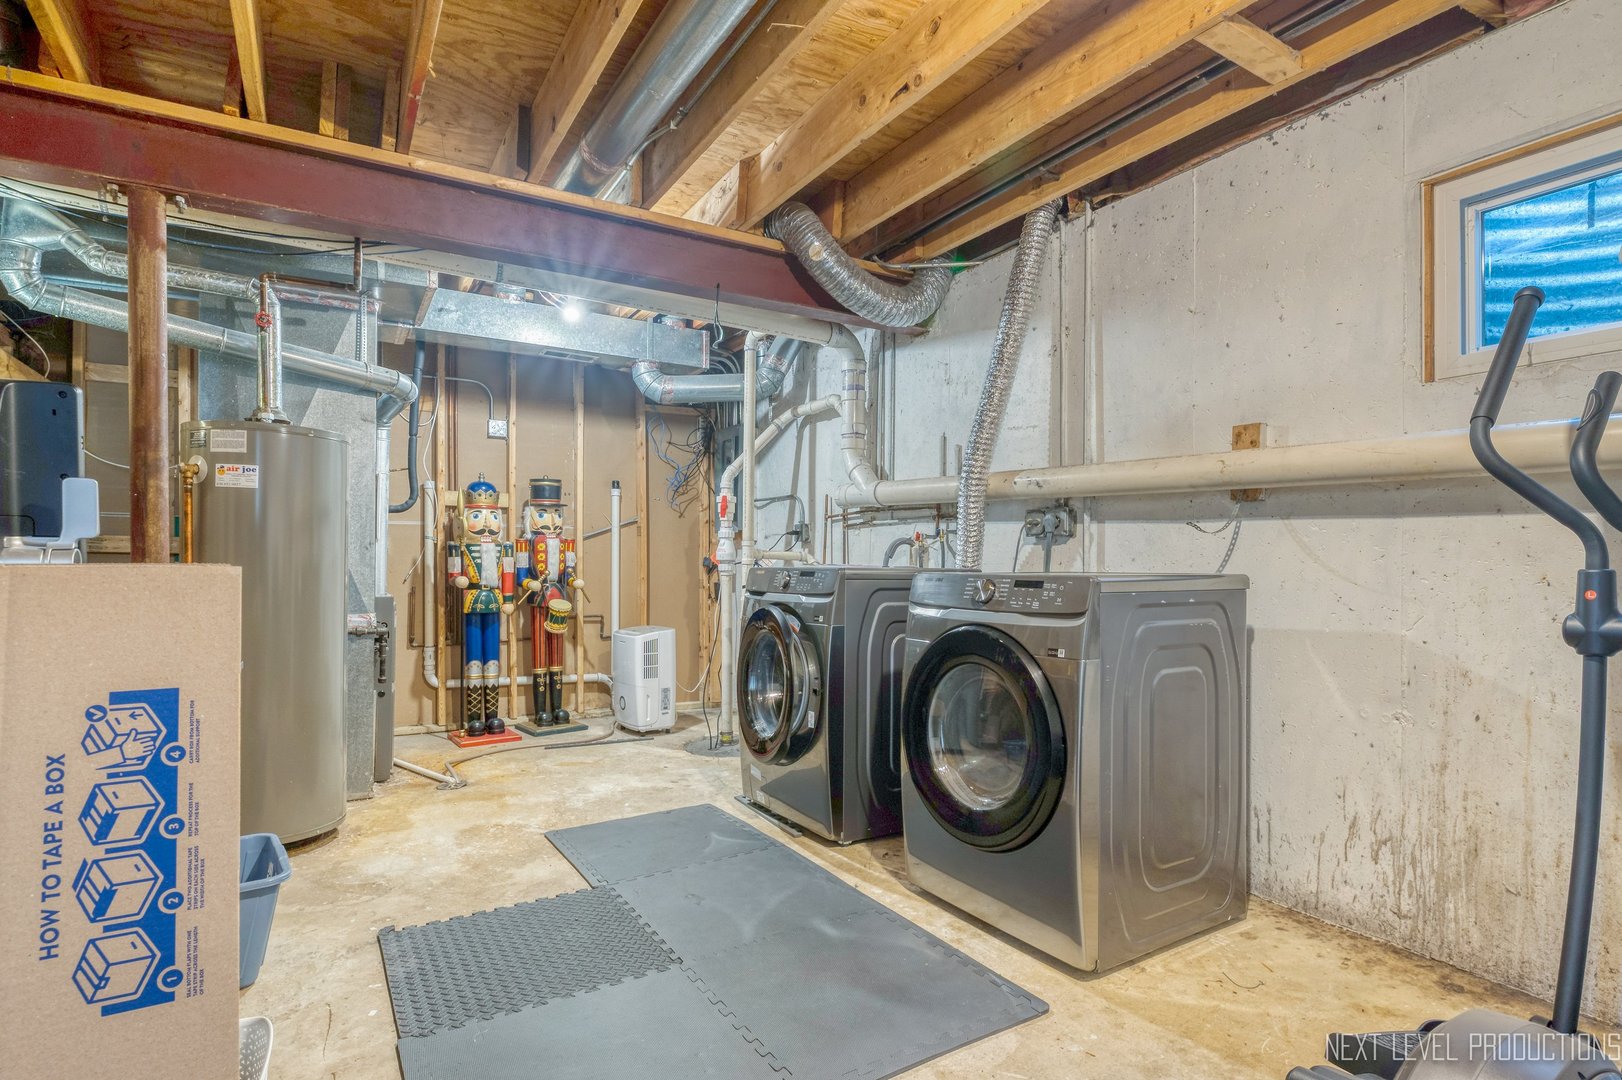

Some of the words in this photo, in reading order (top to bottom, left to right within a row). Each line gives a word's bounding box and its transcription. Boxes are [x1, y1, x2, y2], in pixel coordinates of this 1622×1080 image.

[242, 465, 257, 473] joe
[170, 750, 180, 758] 4
[45, 753, 65, 795] BOX
[44, 800, 64, 814] A
[43, 820, 63, 870] TAPE
[42, 874, 61, 902] TO
[168, 897, 178, 905] 2
[39, 910, 60, 960] HOW
